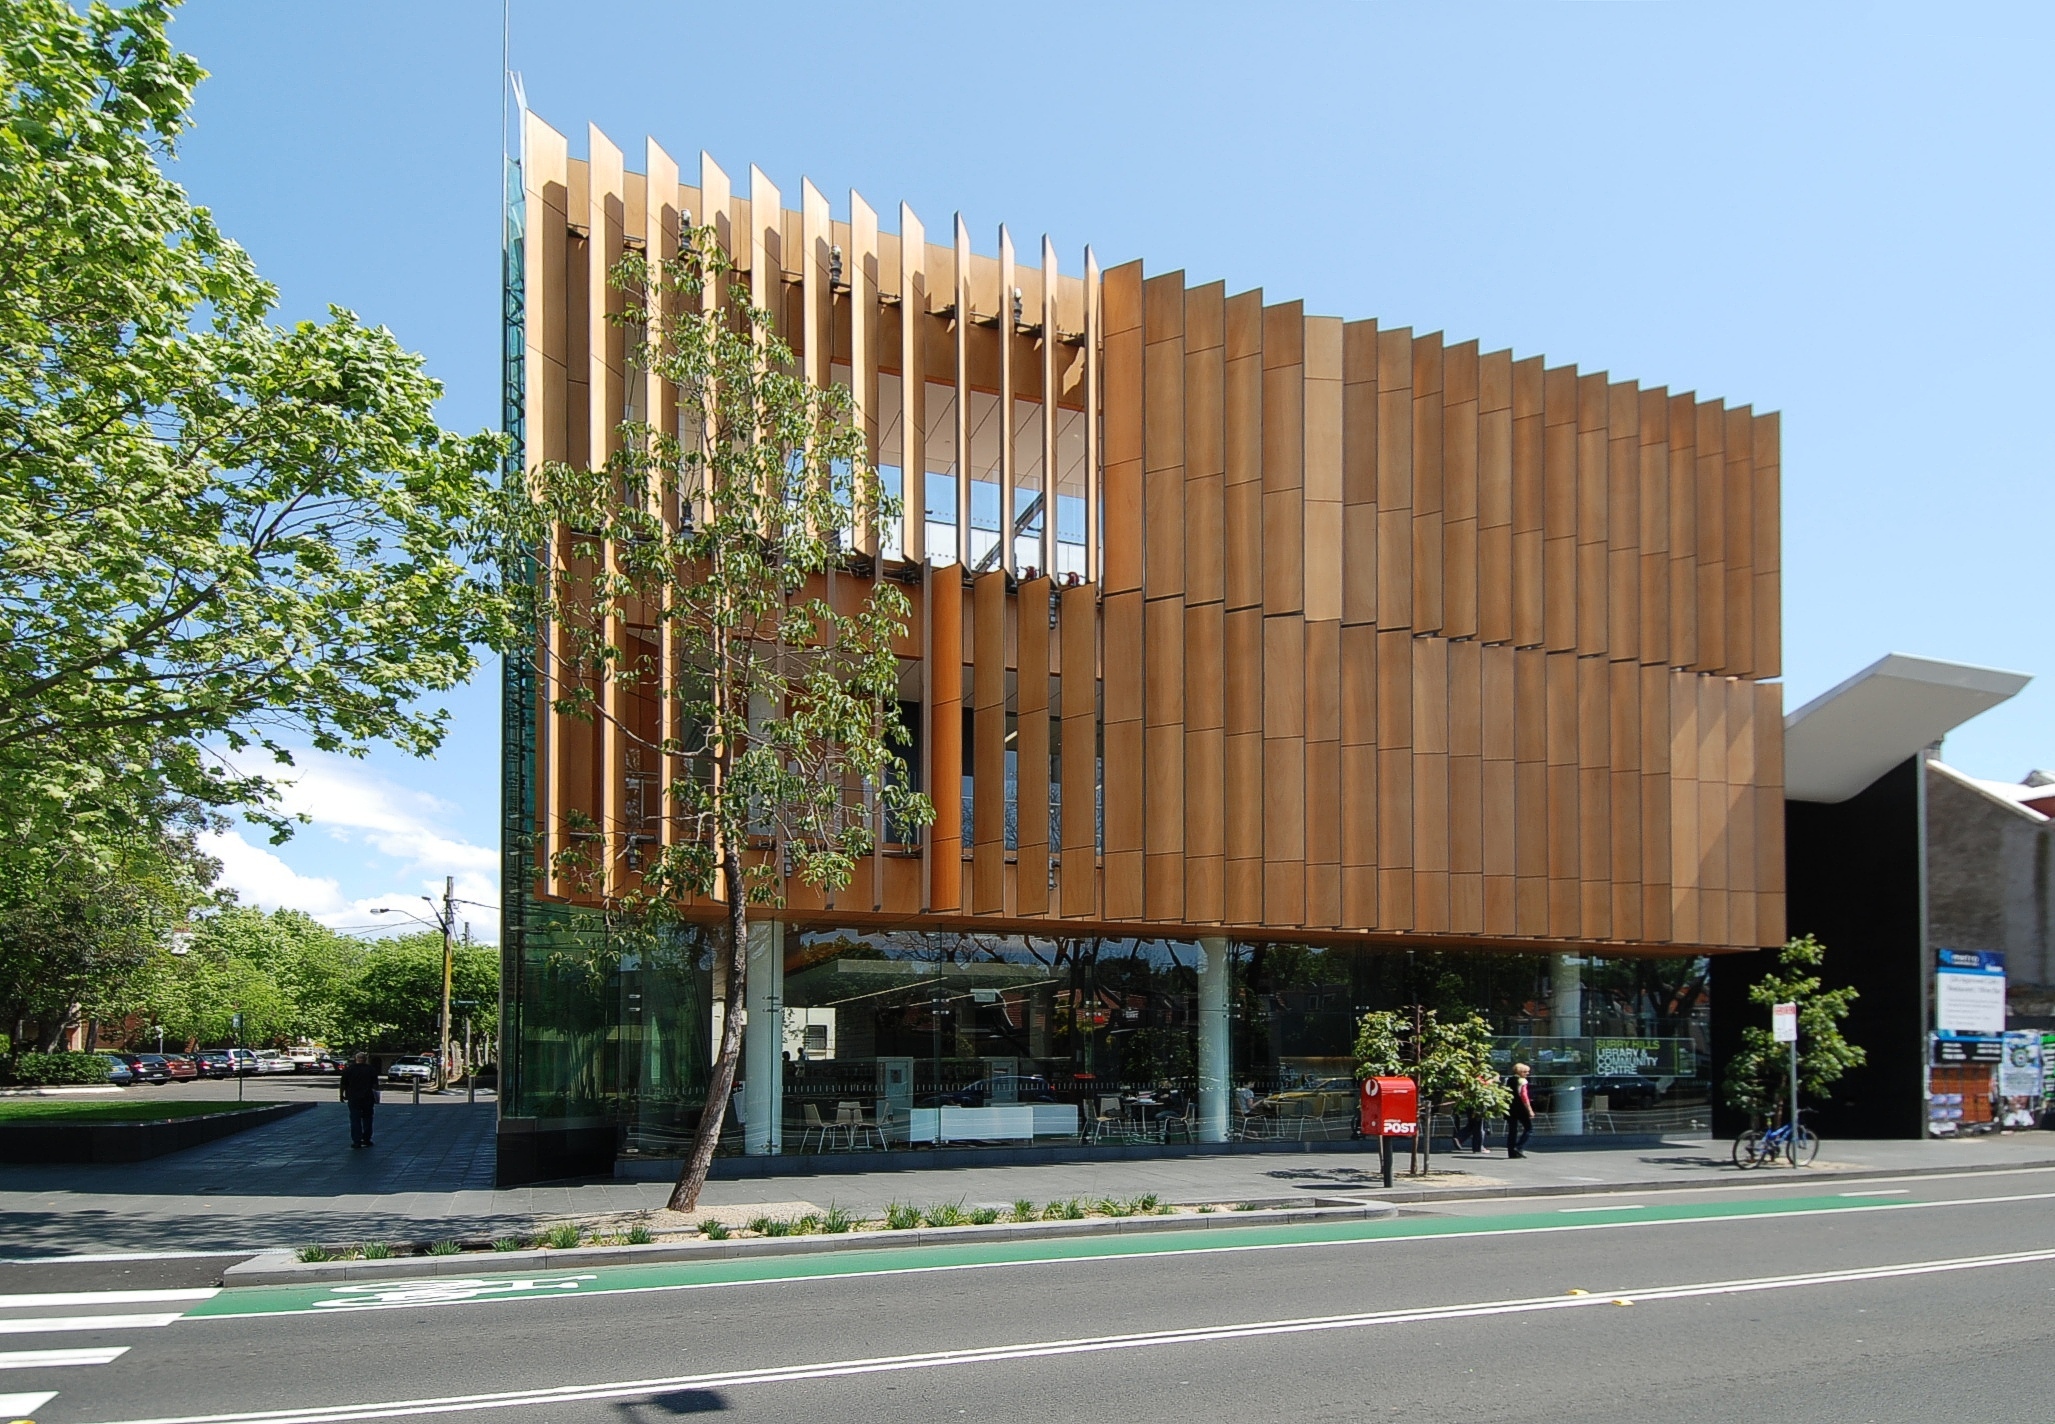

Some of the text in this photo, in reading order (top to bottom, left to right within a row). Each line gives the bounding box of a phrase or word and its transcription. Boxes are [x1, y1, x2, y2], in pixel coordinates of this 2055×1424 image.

[1596, 1040, 1660, 1049] SURRY HILLS
[1596, 1048, 1648, 1057] LIBRARY &
[1596, 1057, 1659, 1066] COMMUNITY
[1597, 1065, 1638, 1075] CENTRE
[1383, 1122, 1417, 1133] POST
